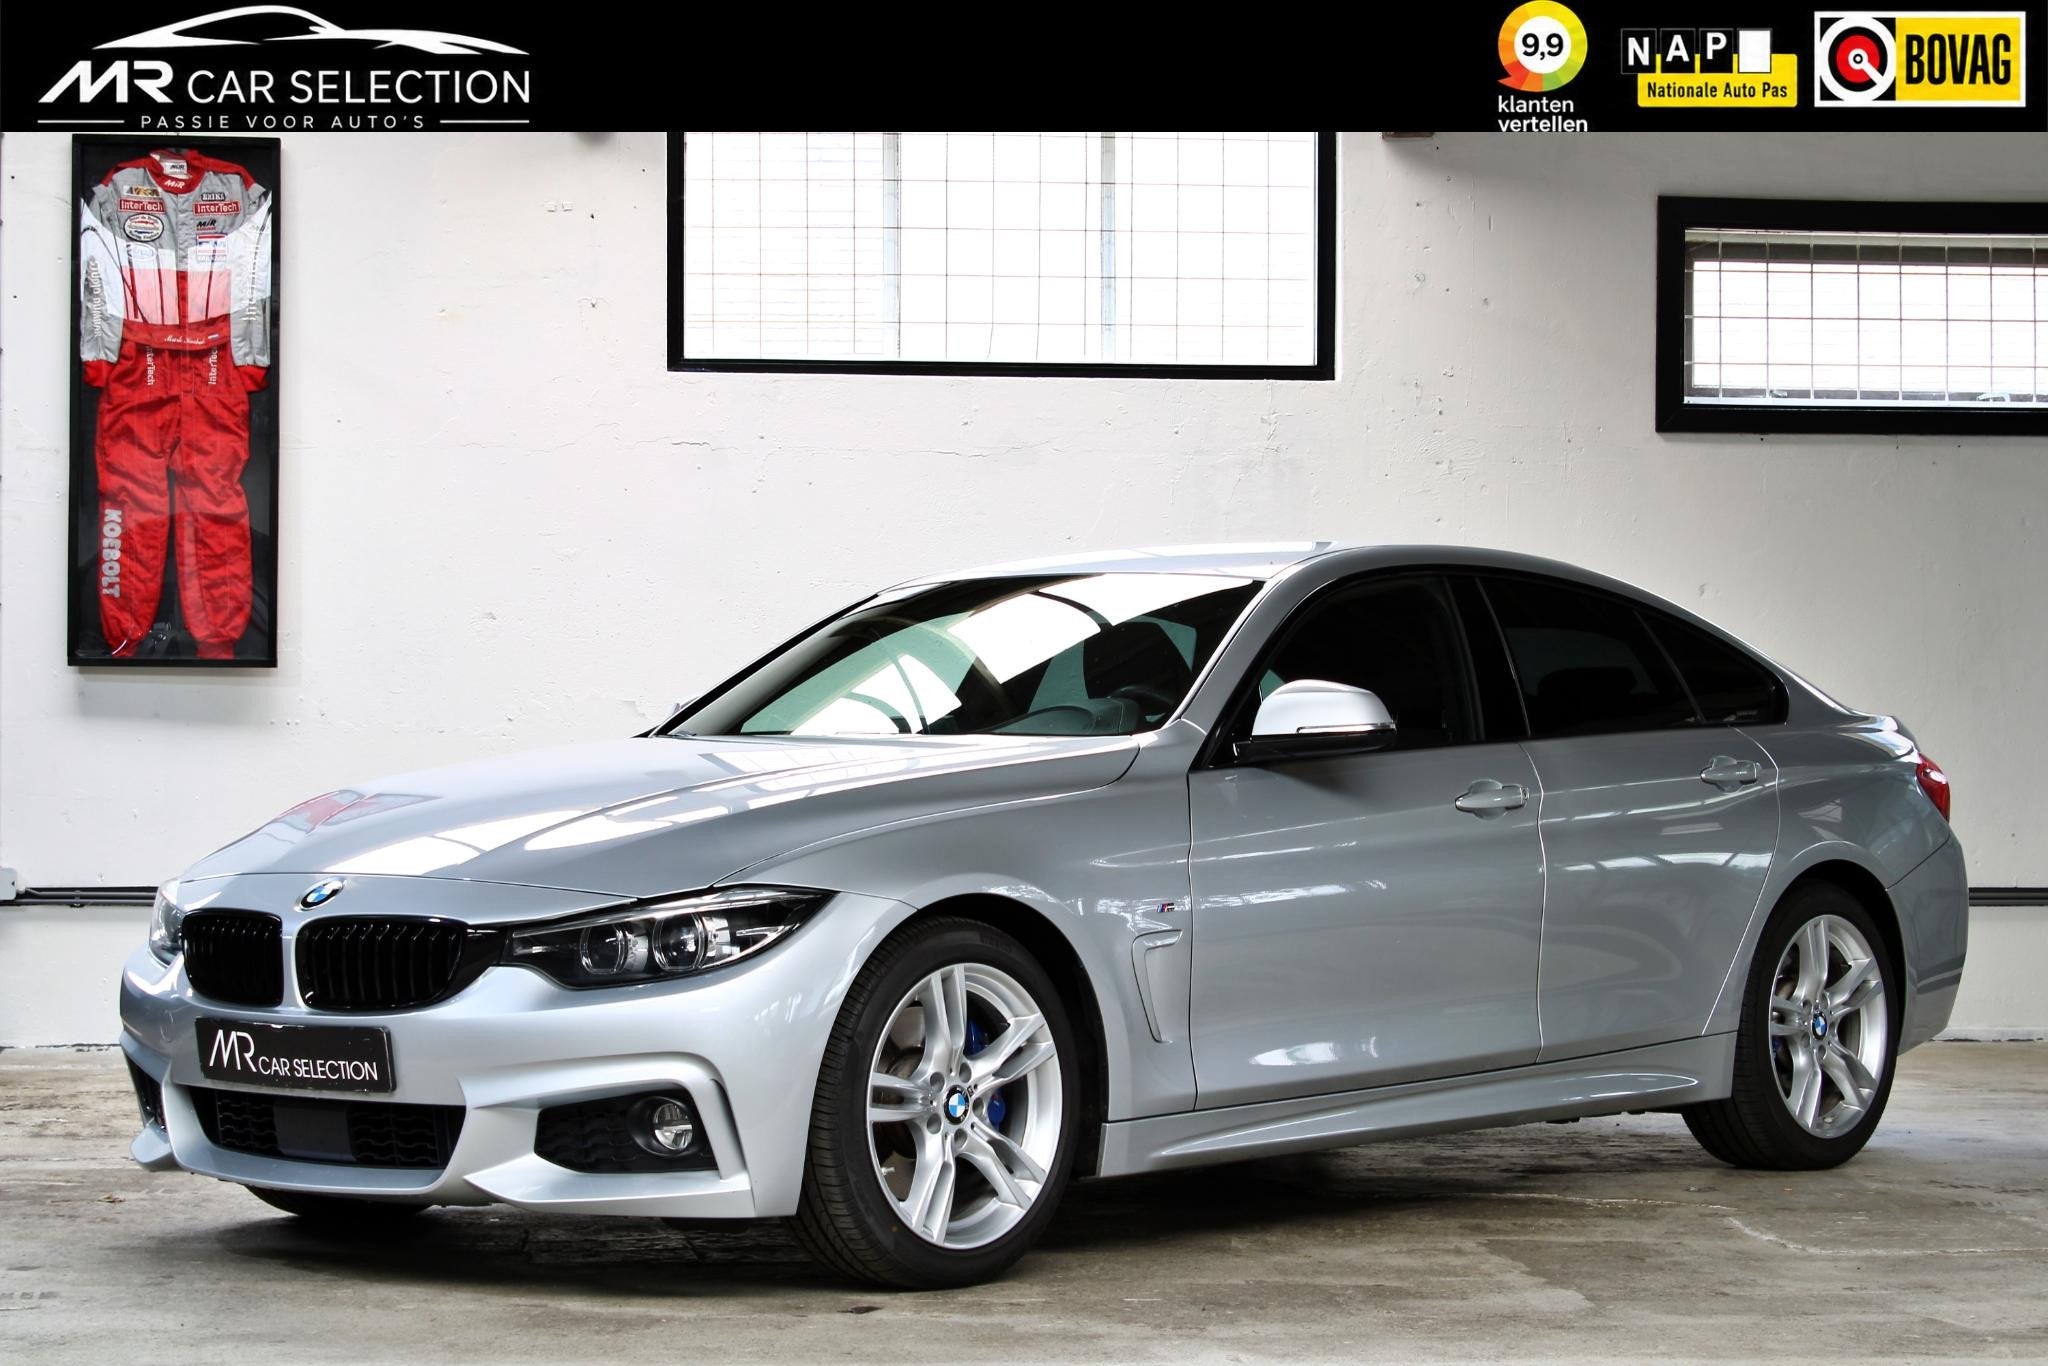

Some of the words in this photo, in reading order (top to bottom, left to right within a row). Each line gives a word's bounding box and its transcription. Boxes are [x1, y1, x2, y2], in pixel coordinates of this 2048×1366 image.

[121, 200, 163, 210] InterTech
[197, 202, 237, 213] InterTech
[102, 509, 122, 598] KOEBOLT
[209, 1029, 257, 1073] MR
[258, 1056, 291, 1077] CAR
[293, 1058, 379, 1081] SELECTION
